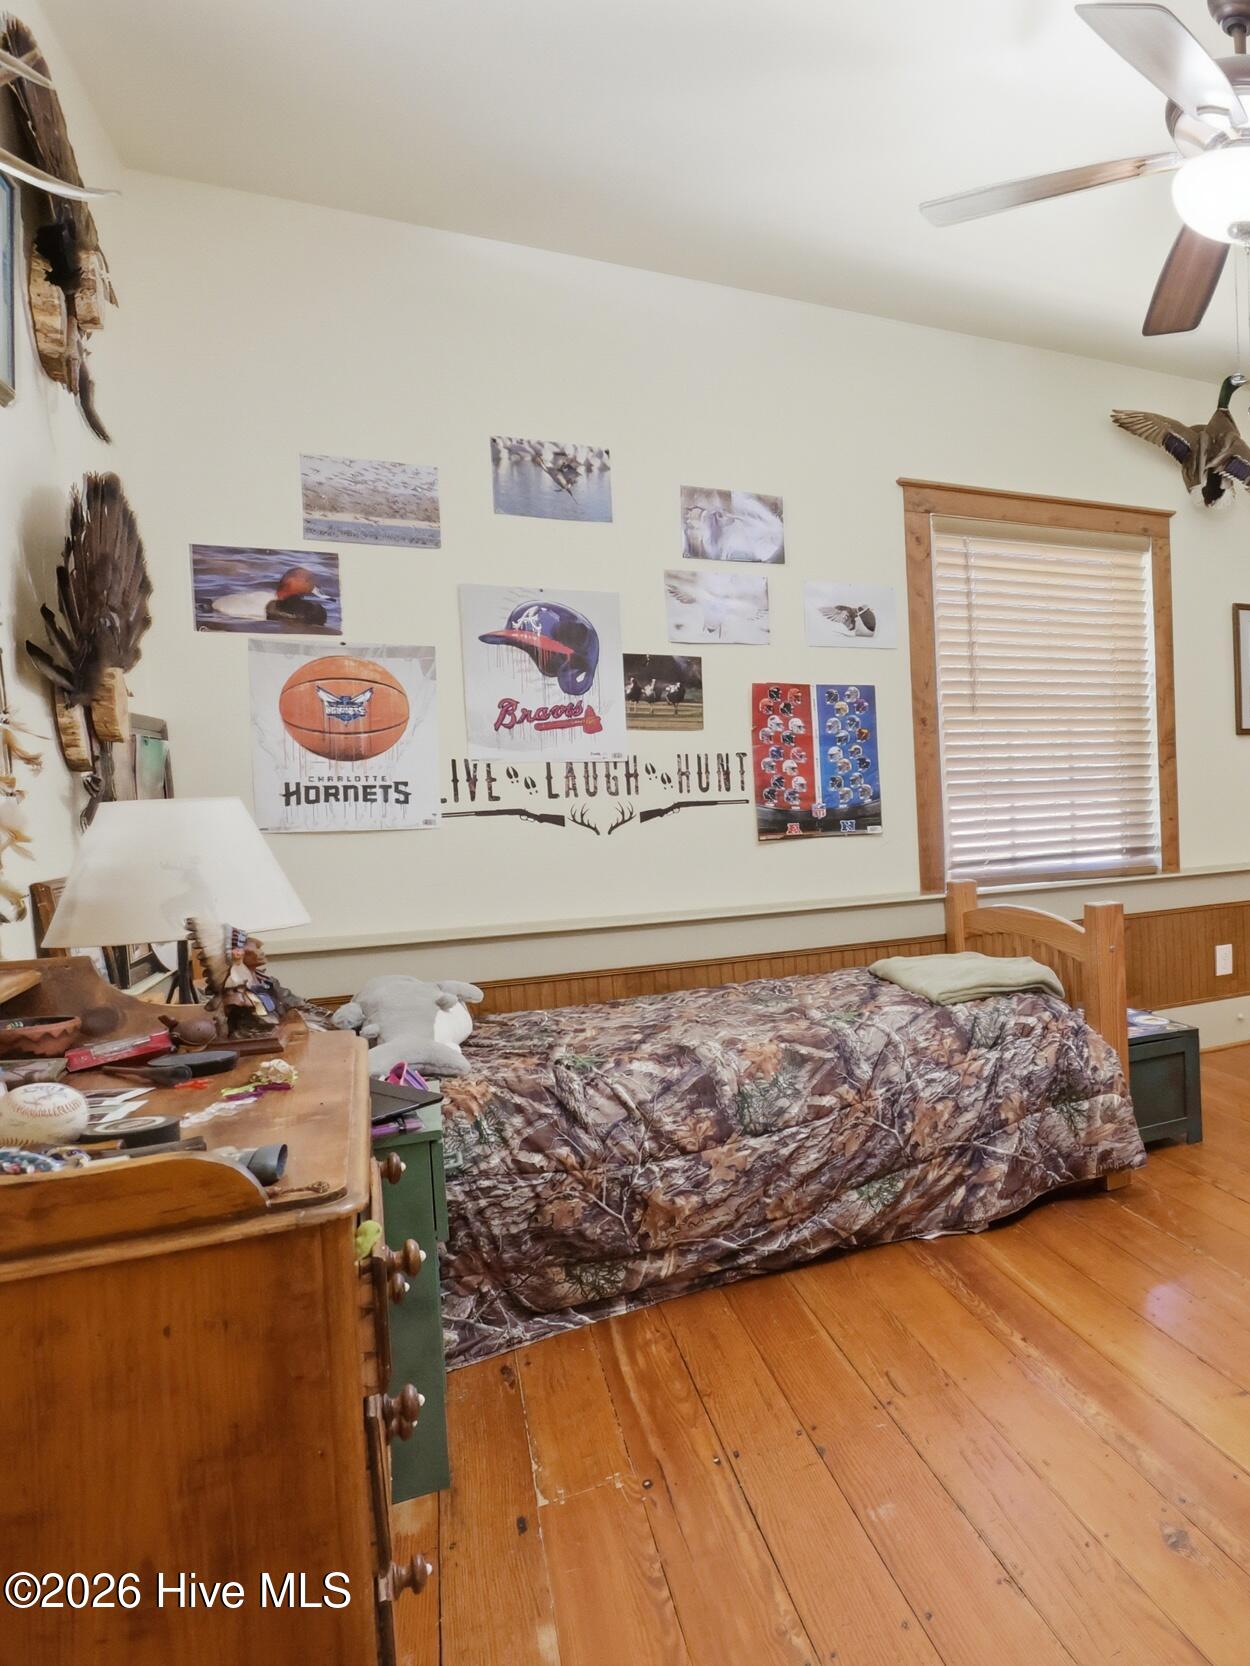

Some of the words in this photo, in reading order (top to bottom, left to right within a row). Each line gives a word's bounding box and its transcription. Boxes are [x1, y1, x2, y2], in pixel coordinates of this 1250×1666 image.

[494, 698, 583, 731] Braves
[308, 775, 388, 783] CHARLOTTE
[440, 758, 501, 803] IVE
[545, 755, 639, 799] LAUGH
[676, 752, 748, 794] HUNT
[281, 781, 412, 806] HORNETS
